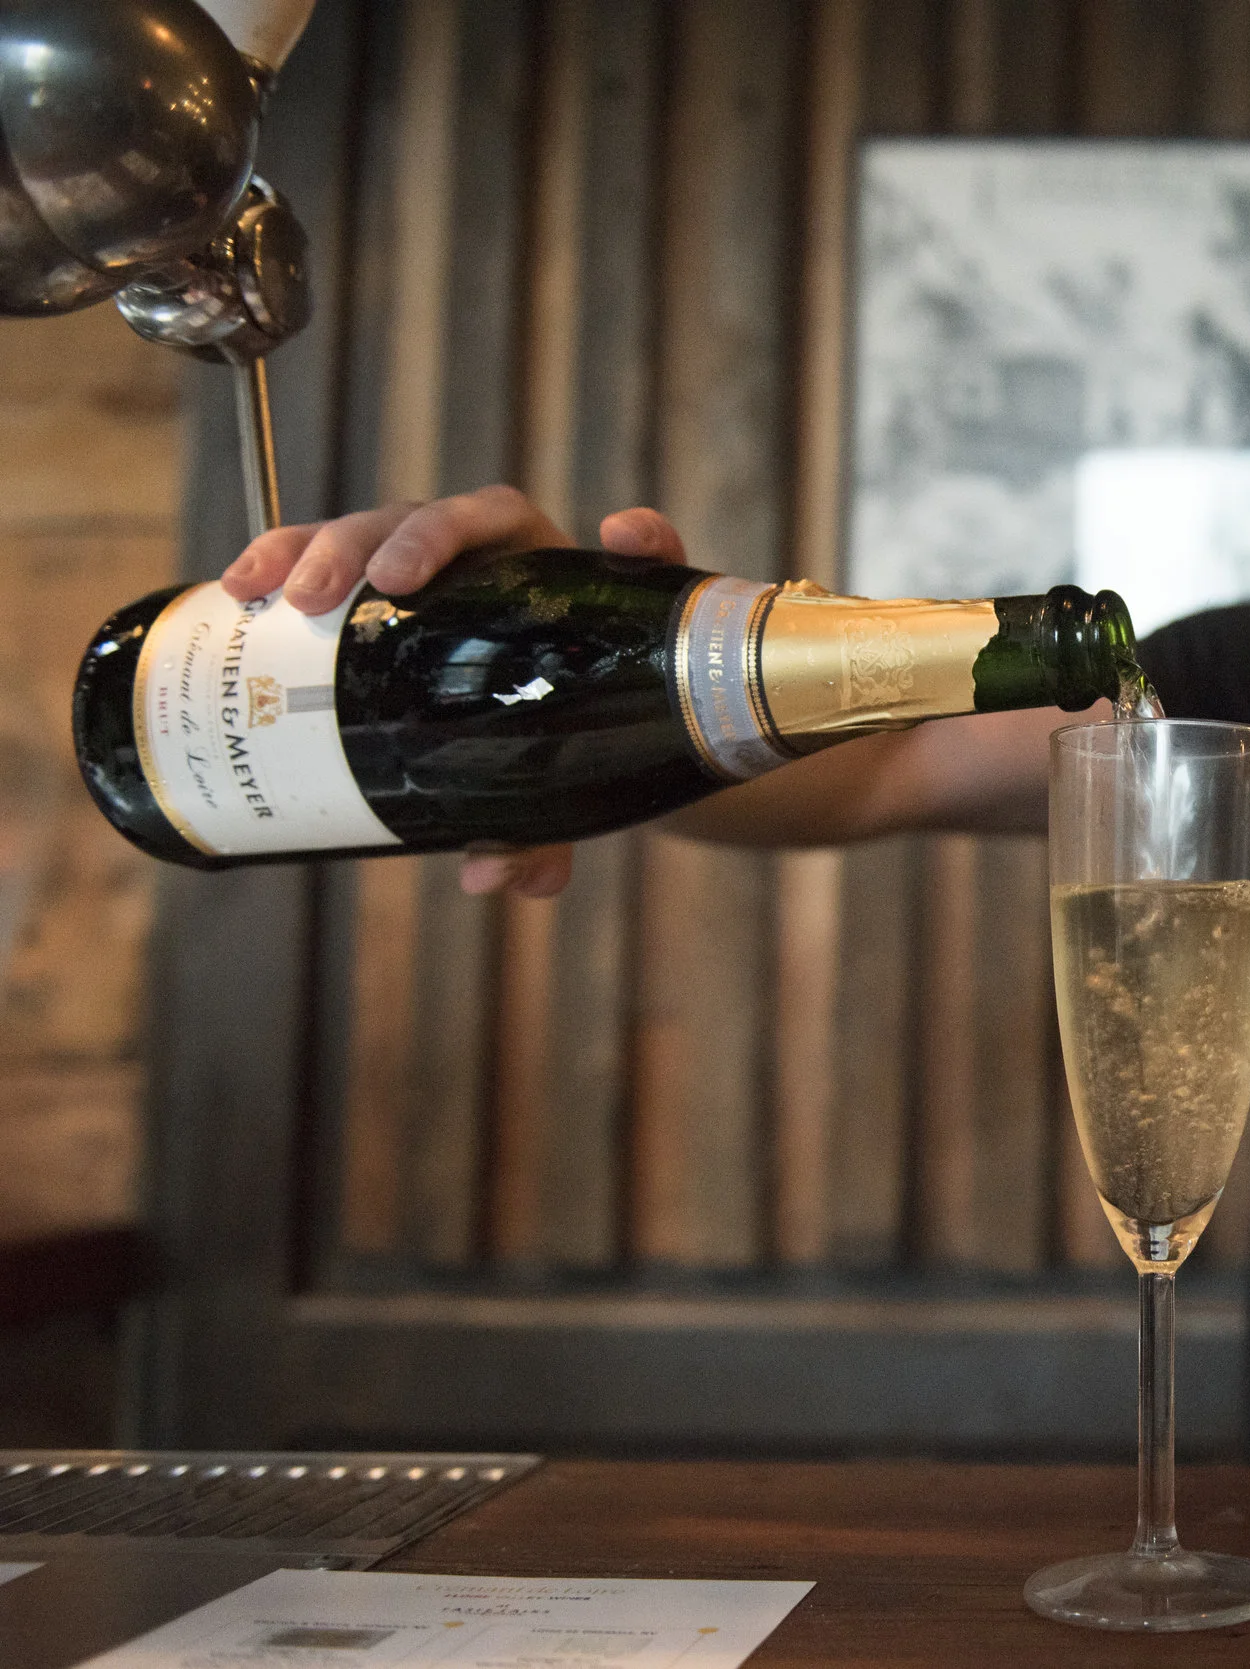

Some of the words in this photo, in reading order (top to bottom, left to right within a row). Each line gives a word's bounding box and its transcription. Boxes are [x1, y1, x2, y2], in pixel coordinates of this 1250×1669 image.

[220, 597, 268, 697] GRATIEN
[708, 668, 724, 684] &
[158, 686, 170, 737] BRUT
[180, 709, 200, 737] de
[221, 706, 239, 728] &
[185, 747, 219, 811] Loire
[224, 733, 274, 821] MEYER
